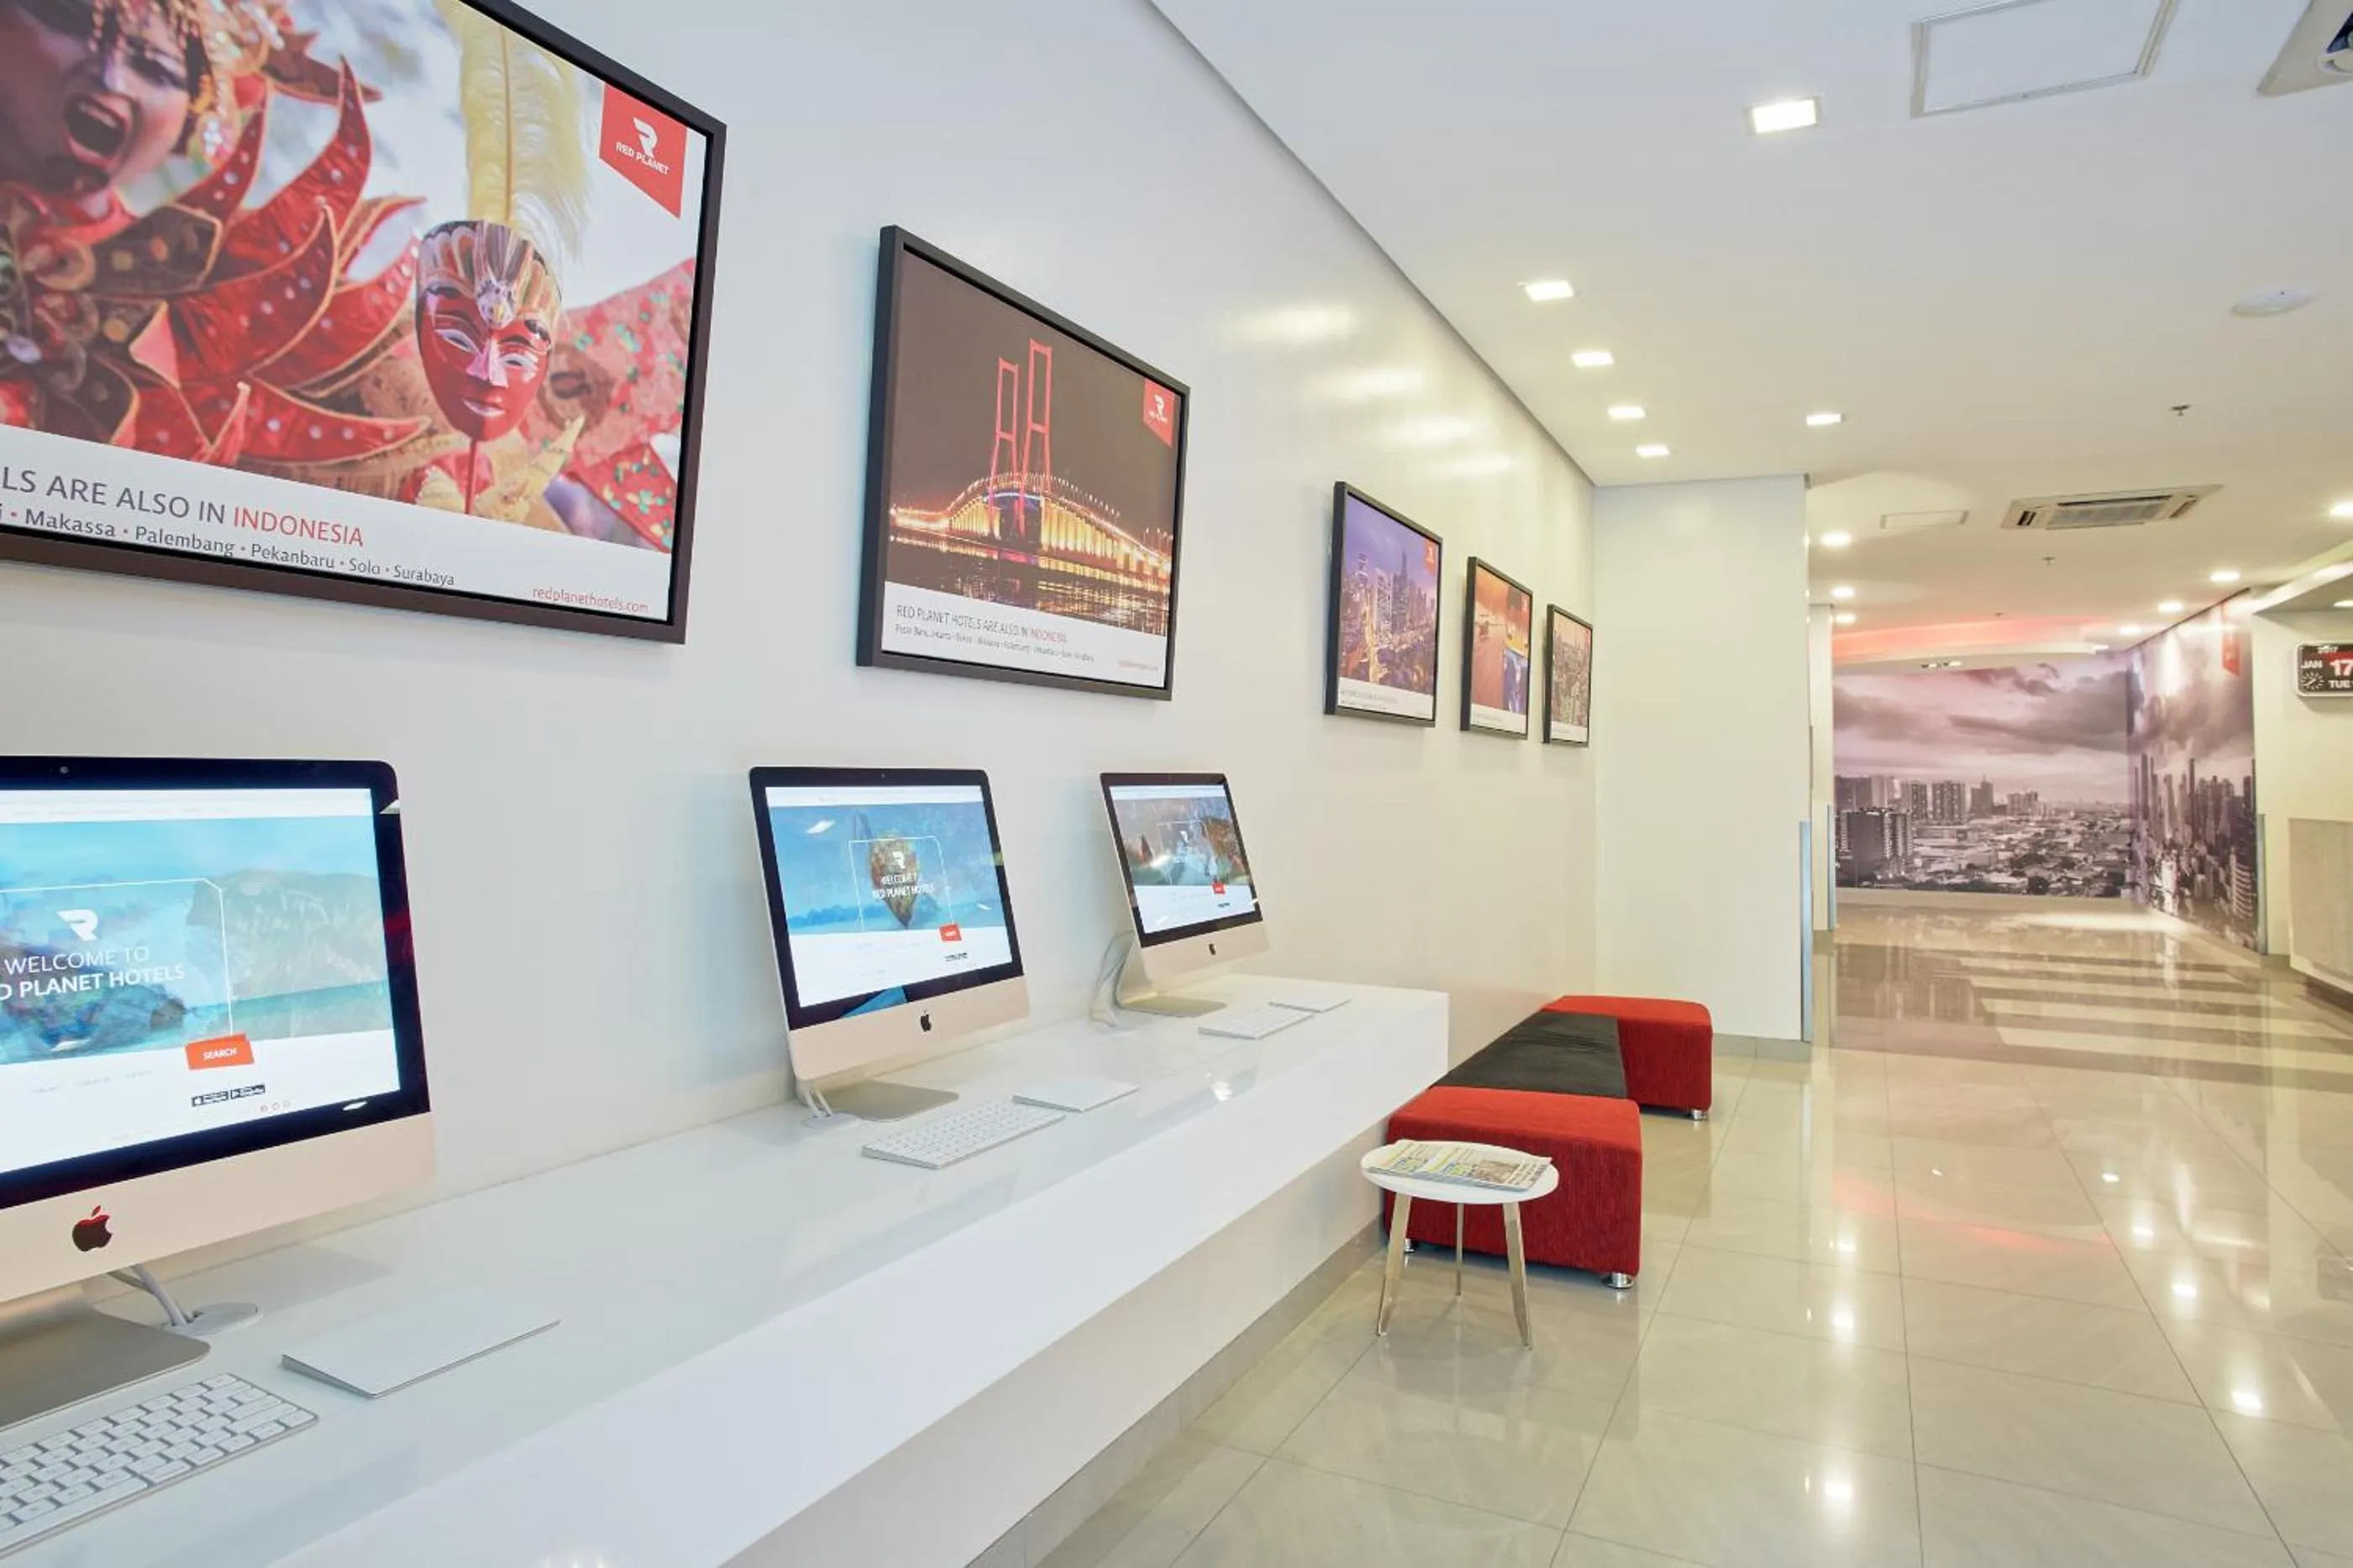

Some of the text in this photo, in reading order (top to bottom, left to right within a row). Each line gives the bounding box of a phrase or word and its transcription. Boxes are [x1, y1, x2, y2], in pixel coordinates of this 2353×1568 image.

[615, 141, 670, 176] RED PLANET
[45, 475, 108, 506] ARE
[116, 487, 189, 519] ALSO
[198, 500, 225, 525] IN
[234, 506, 364, 547] INDONESIA
[25, 508, 115, 538] Makassa
[135, 525, 235, 558] Palembang
[251, 543, 334, 569] Pekanbaru
[349, 558, 381, 575] Solo
[393, 564, 454, 587] Surabaya
[533, 586, 649, 613] redplanethotels.com
[2301, 659, 2323, 669] JAN
[2329, 658, 2353, 677] 17
[2328, 679, 2350, 689] TUE
[4, 946, 150, 976] WELCOME TO
[19, 973, 104, 999] PLANET
[109, 962, 186, 989] HOTELS
[202, 1046, 238, 1061] SEARCH
